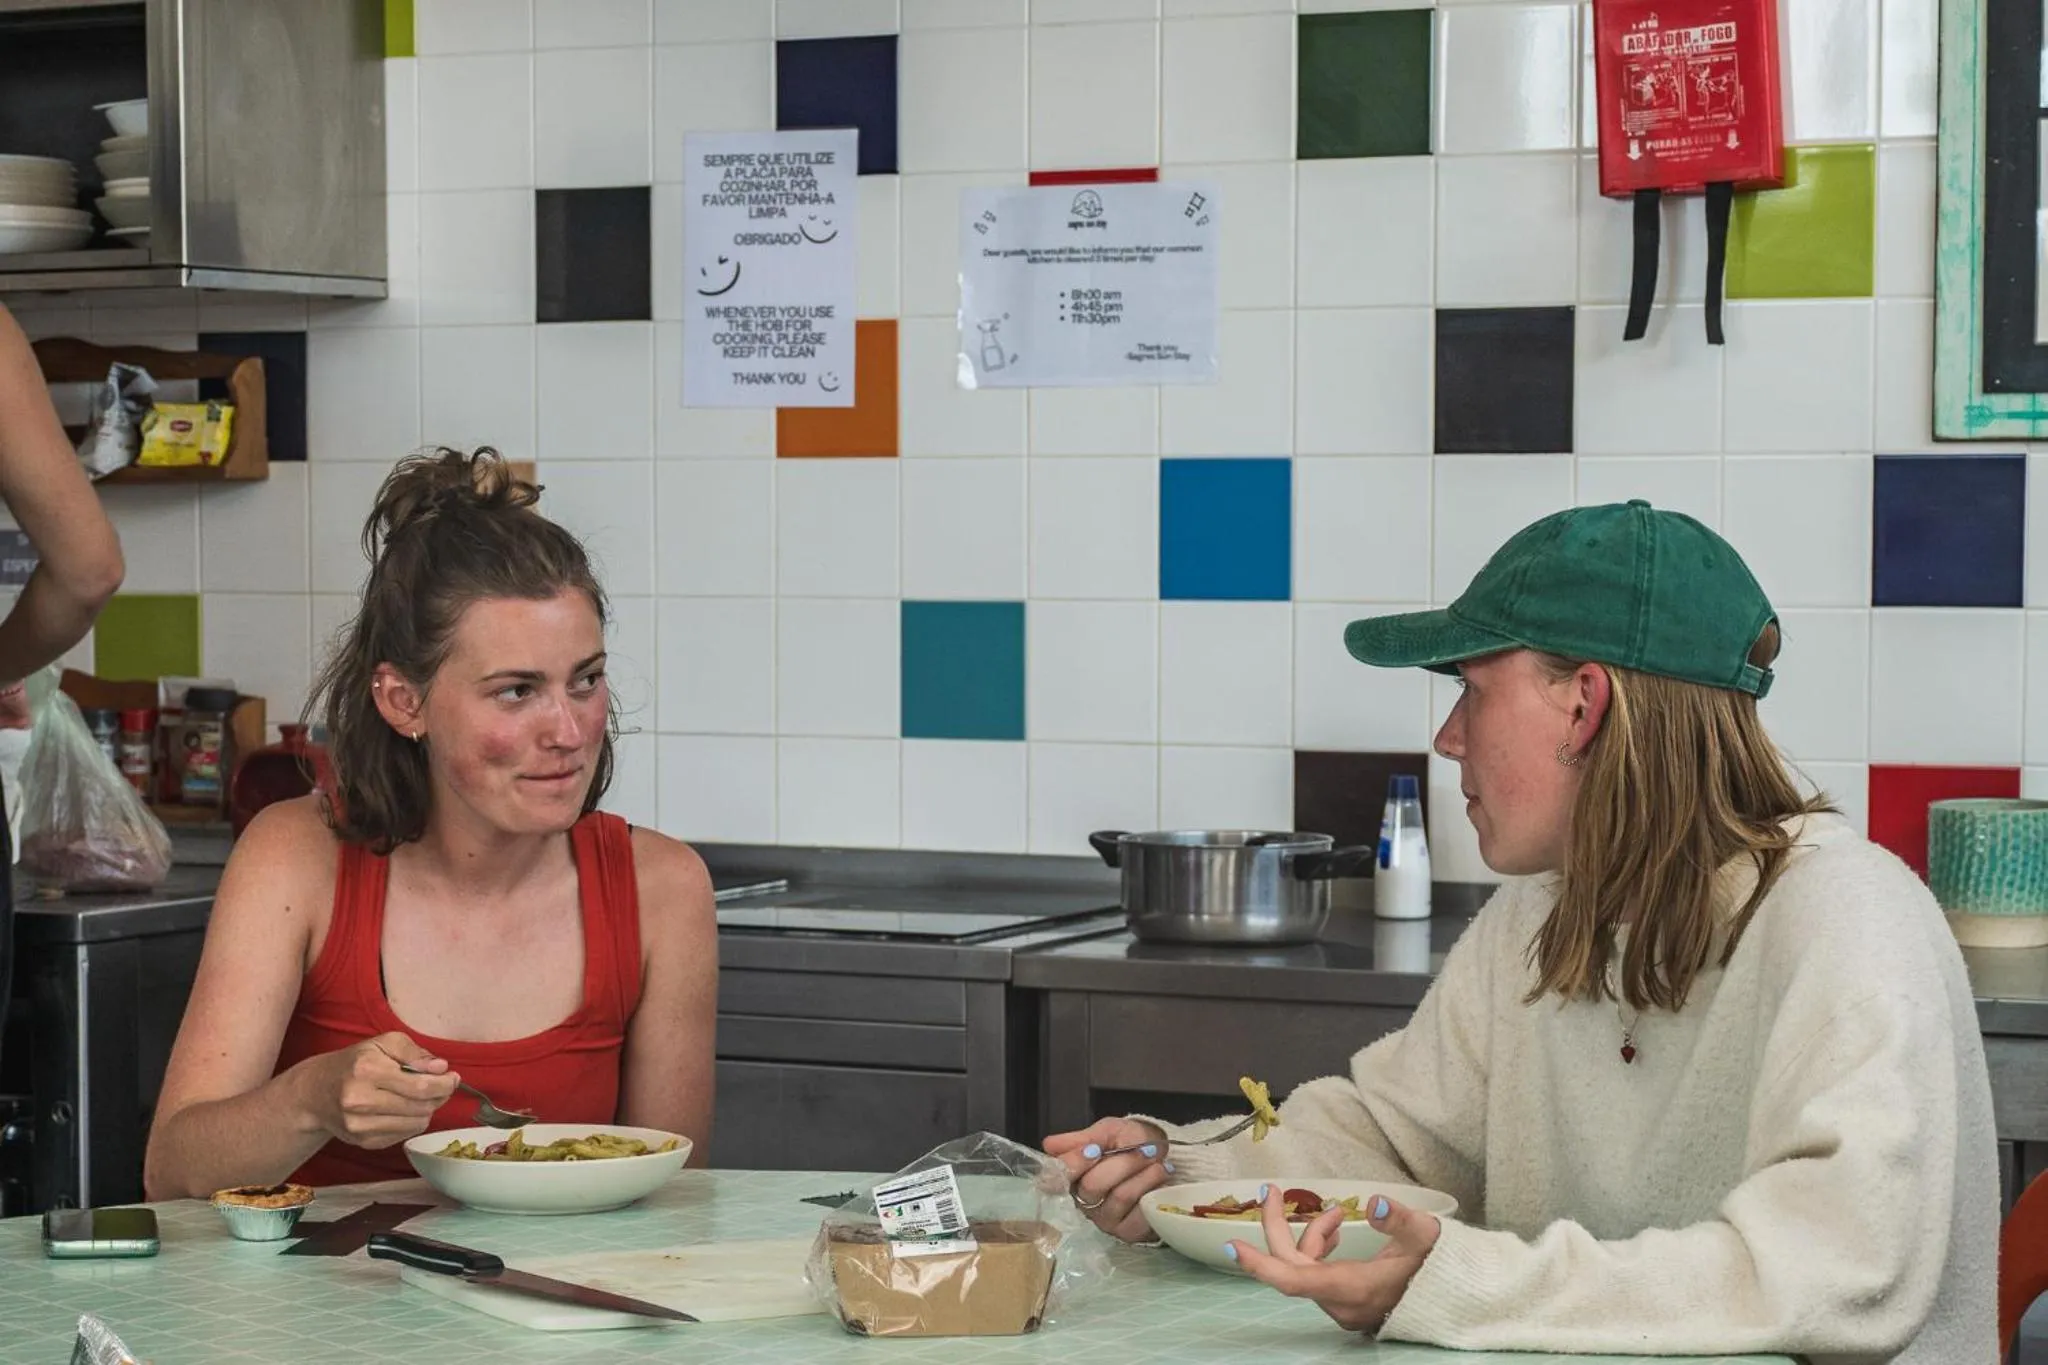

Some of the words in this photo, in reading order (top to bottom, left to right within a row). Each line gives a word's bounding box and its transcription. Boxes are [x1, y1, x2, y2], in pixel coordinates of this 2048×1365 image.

[1701, 26, 1733, 42] FOGO
[704, 153, 755, 167] SEMPRE
[757, 152, 784, 167] QUE
[787, 151, 835, 165] UTILIZE
[723, 167, 732, 179] A
[780, 165, 814, 178] PARA
[790, 179, 818, 191] POR
[702, 193, 745, 206] FAVOR
[748, 191, 836, 205] MANTENHA-A
[748, 206, 787, 219] LIMPA
[734, 232, 801, 245] OBRIGADO
[705, 305, 776, 319] WHENEVER
[779, 305, 806, 318] YOU
[809, 305, 835, 318] USE
[1072, 301, 1102, 312] 4h45
[1104, 303, 1123, 313] pm
[727, 319, 752, 331] THE
[756, 319, 783, 331] HOB
[786, 319, 812, 331] FOR
[777, 331, 827, 345] PLEASE
[723, 345, 756, 358] KEEP
[758, 346, 768, 358] IT
[771, 345, 815, 358] CLEAN
[732, 371, 776, 385] THANK
[778, 371, 806, 385] YOU
